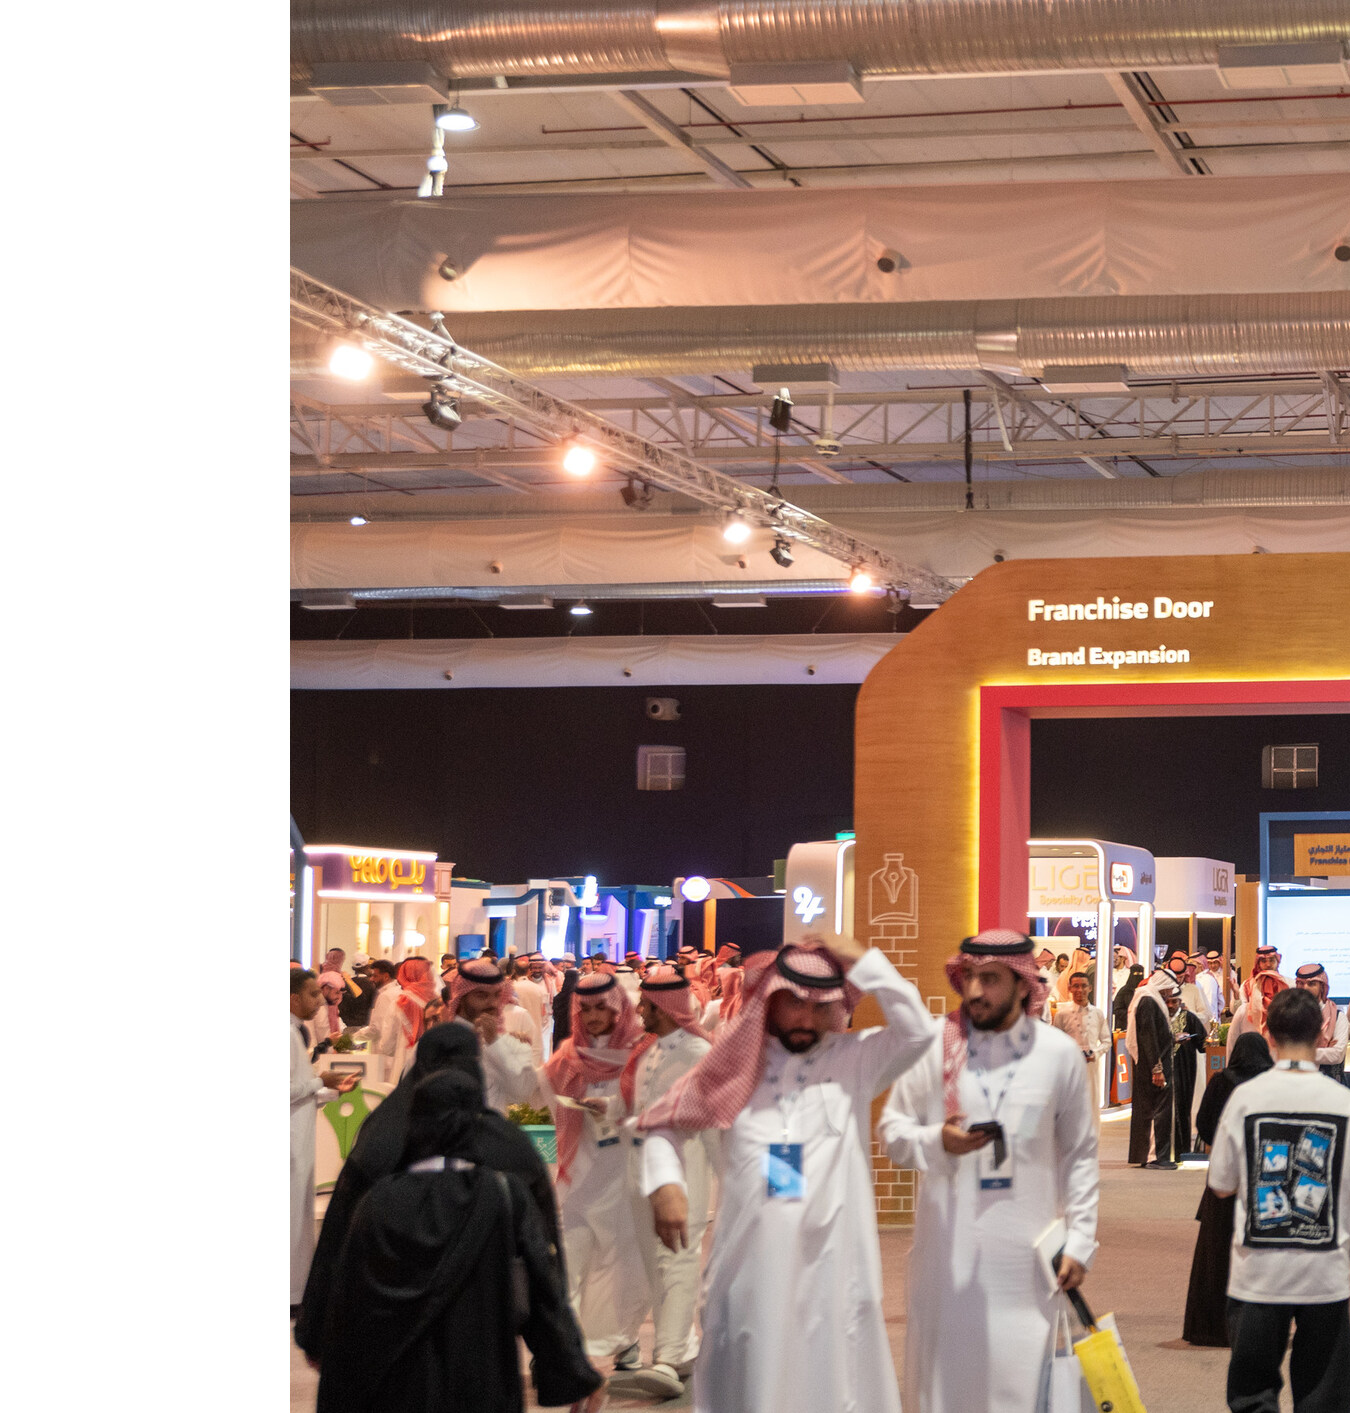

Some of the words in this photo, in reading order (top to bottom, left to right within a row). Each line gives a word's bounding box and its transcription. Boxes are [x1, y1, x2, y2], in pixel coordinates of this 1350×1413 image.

[1028, 596, 1149, 621] Franchise
[1154, 596, 1214, 619] Door
[1027, 646, 1086, 666] Brand
[1089, 644, 1190, 669] Expansion
[1310, 856, 1348, 865] Franchise
[1031, 865, 1098, 890] LIGE
